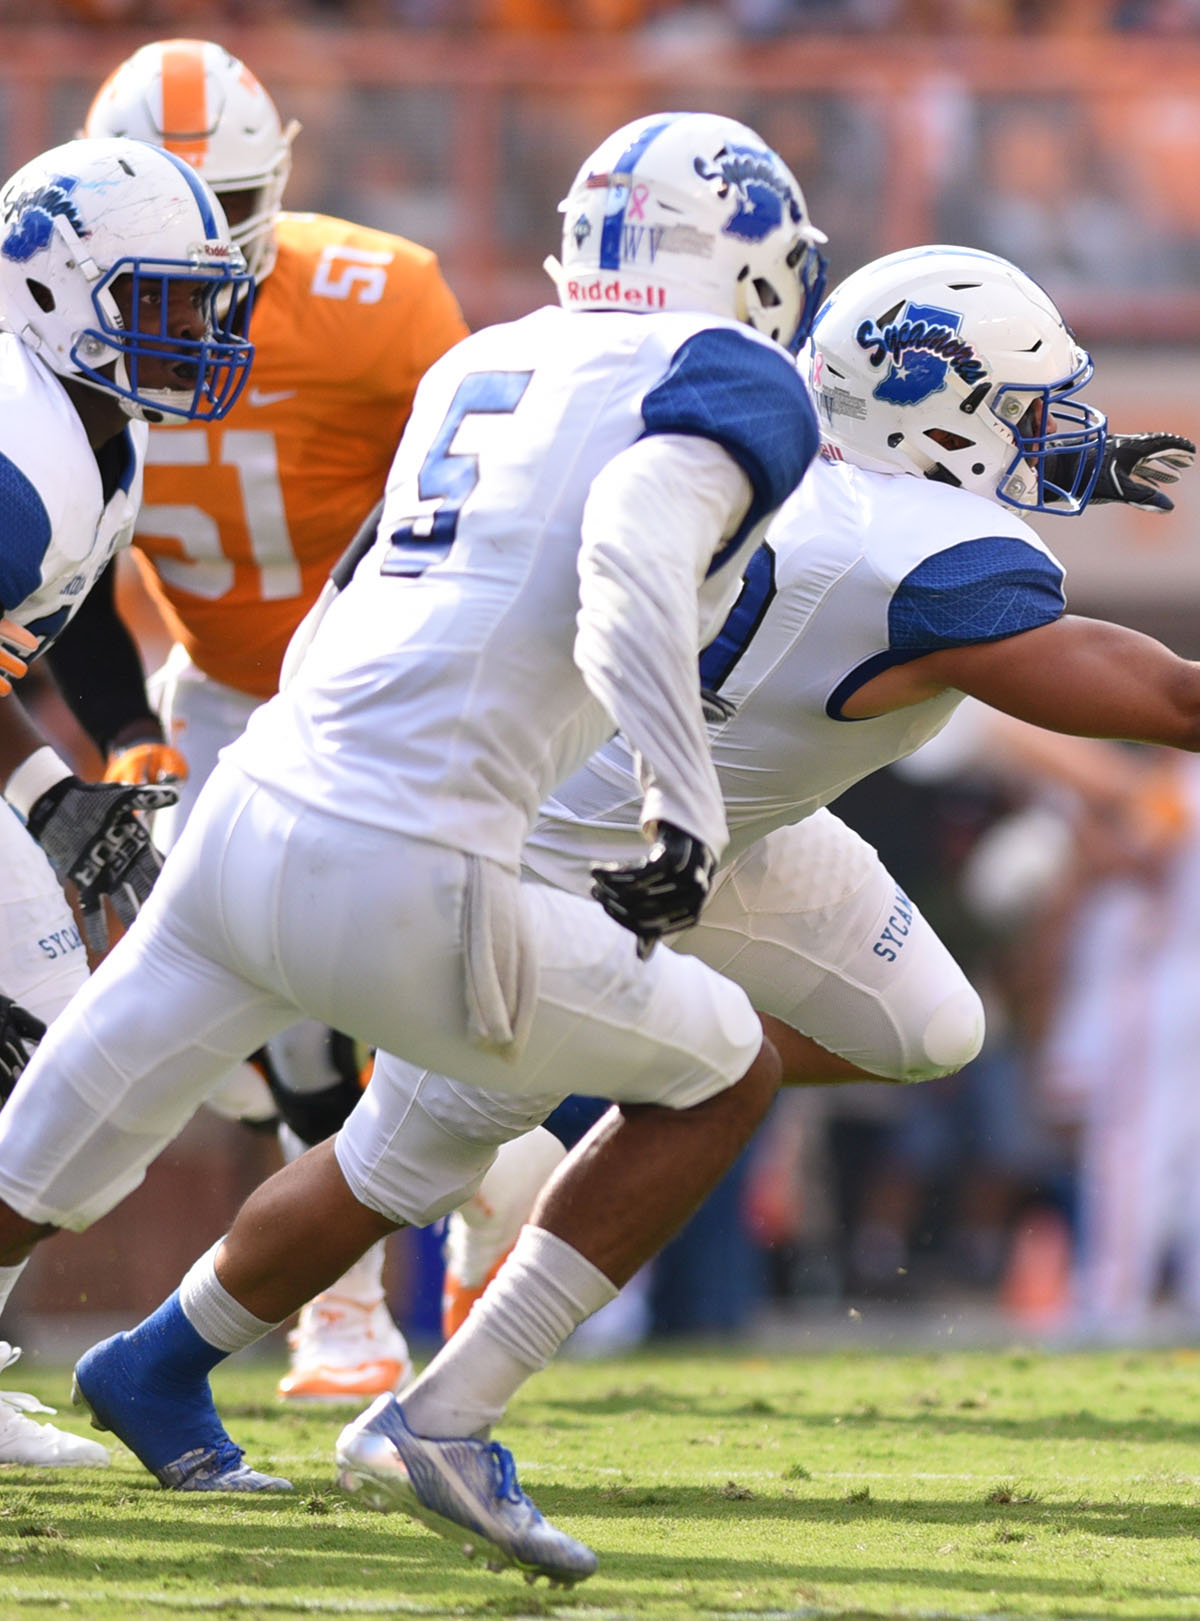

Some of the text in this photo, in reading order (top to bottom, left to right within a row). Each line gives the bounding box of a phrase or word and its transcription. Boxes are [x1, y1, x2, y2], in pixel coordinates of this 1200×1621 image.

[311, 246, 394, 304] 51
[567, 279, 665, 309] Riddell
[132, 430, 302, 600] 51
[380, 369, 537, 578] 5
